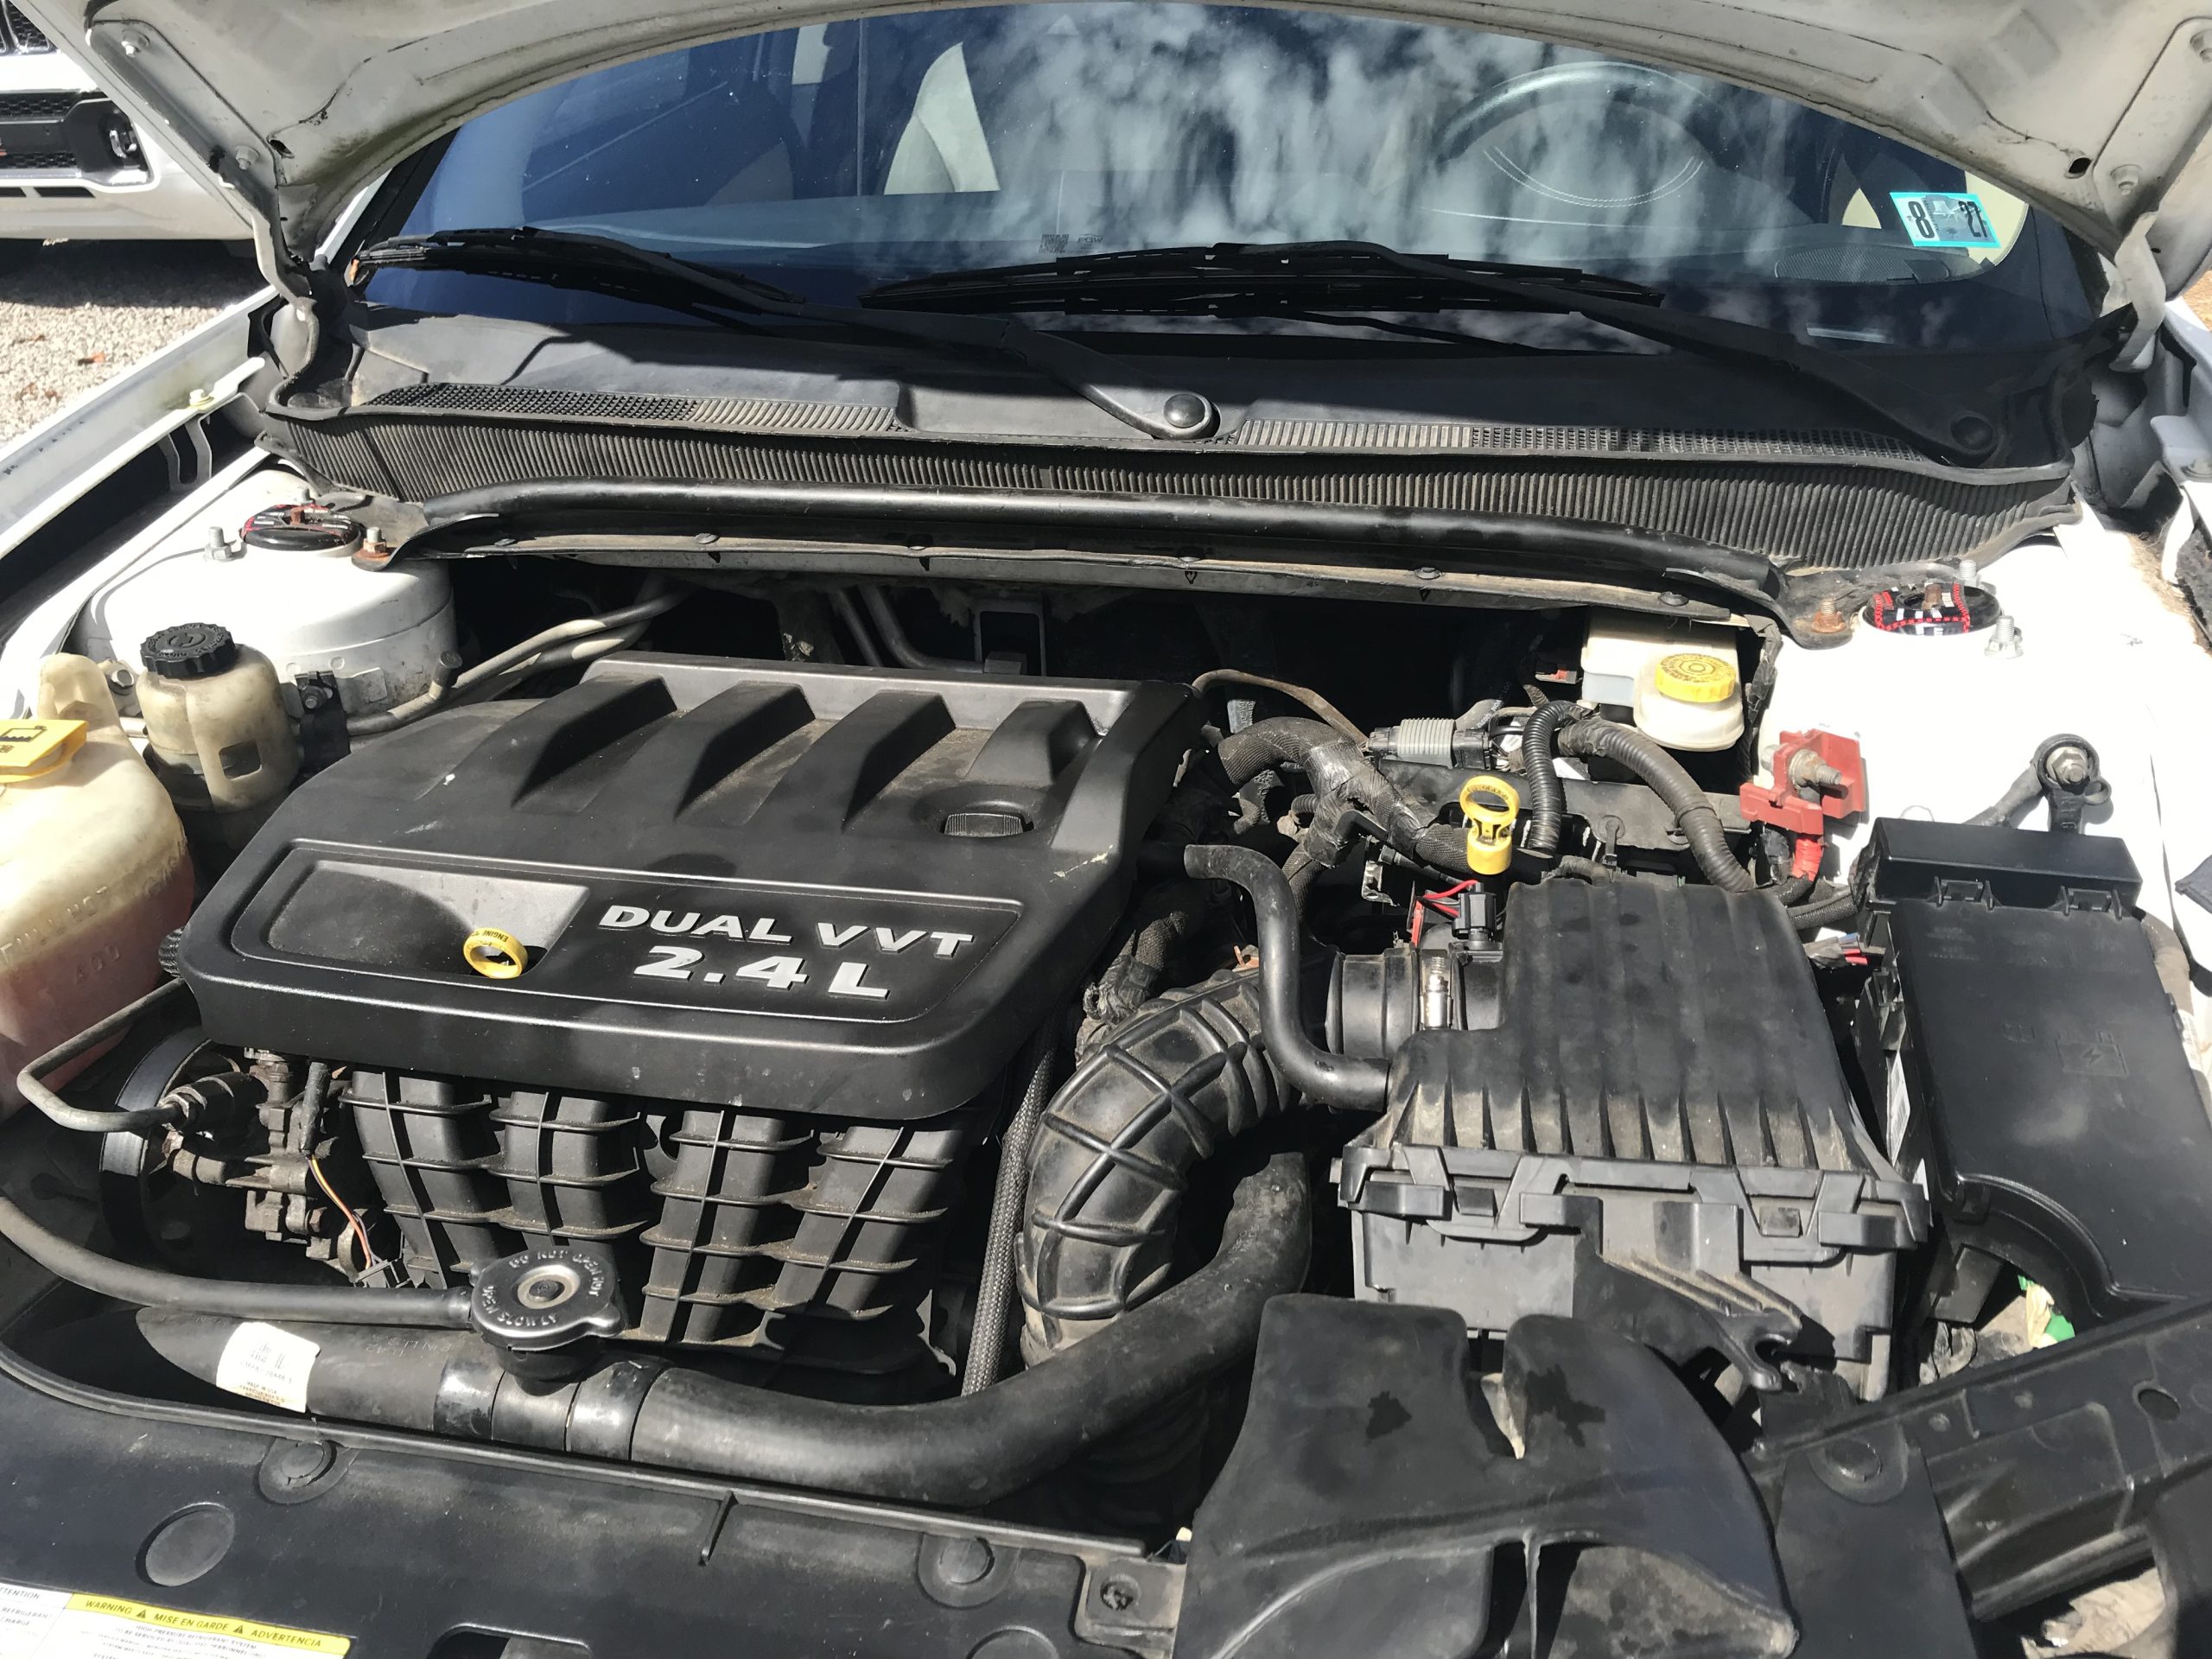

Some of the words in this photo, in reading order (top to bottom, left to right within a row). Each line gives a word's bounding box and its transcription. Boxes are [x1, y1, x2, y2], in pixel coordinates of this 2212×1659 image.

[1908, 200, 1935, 238] 8
[483, 930, 509, 943] ENGINE
[598, 905, 793, 944] DUAL
[817, 922, 975, 957] VVT
[633, 945, 810, 990] 2.4
[827, 961, 891, 1001] L
[537, 1249, 569, 1260] NOT
[497, 1312, 557, 1327] SLOWLY
[2, 1606, 51, 1618] REFRIGERAN
[86, 1599, 133, 1615] WARNING
[154, 1613, 178, 1624] MISE
[181, 1618, 194, 1627] EN
[196, 1620, 230, 1631] GARDE
[251, 1629, 321, 1648] ADVERTENCIA
